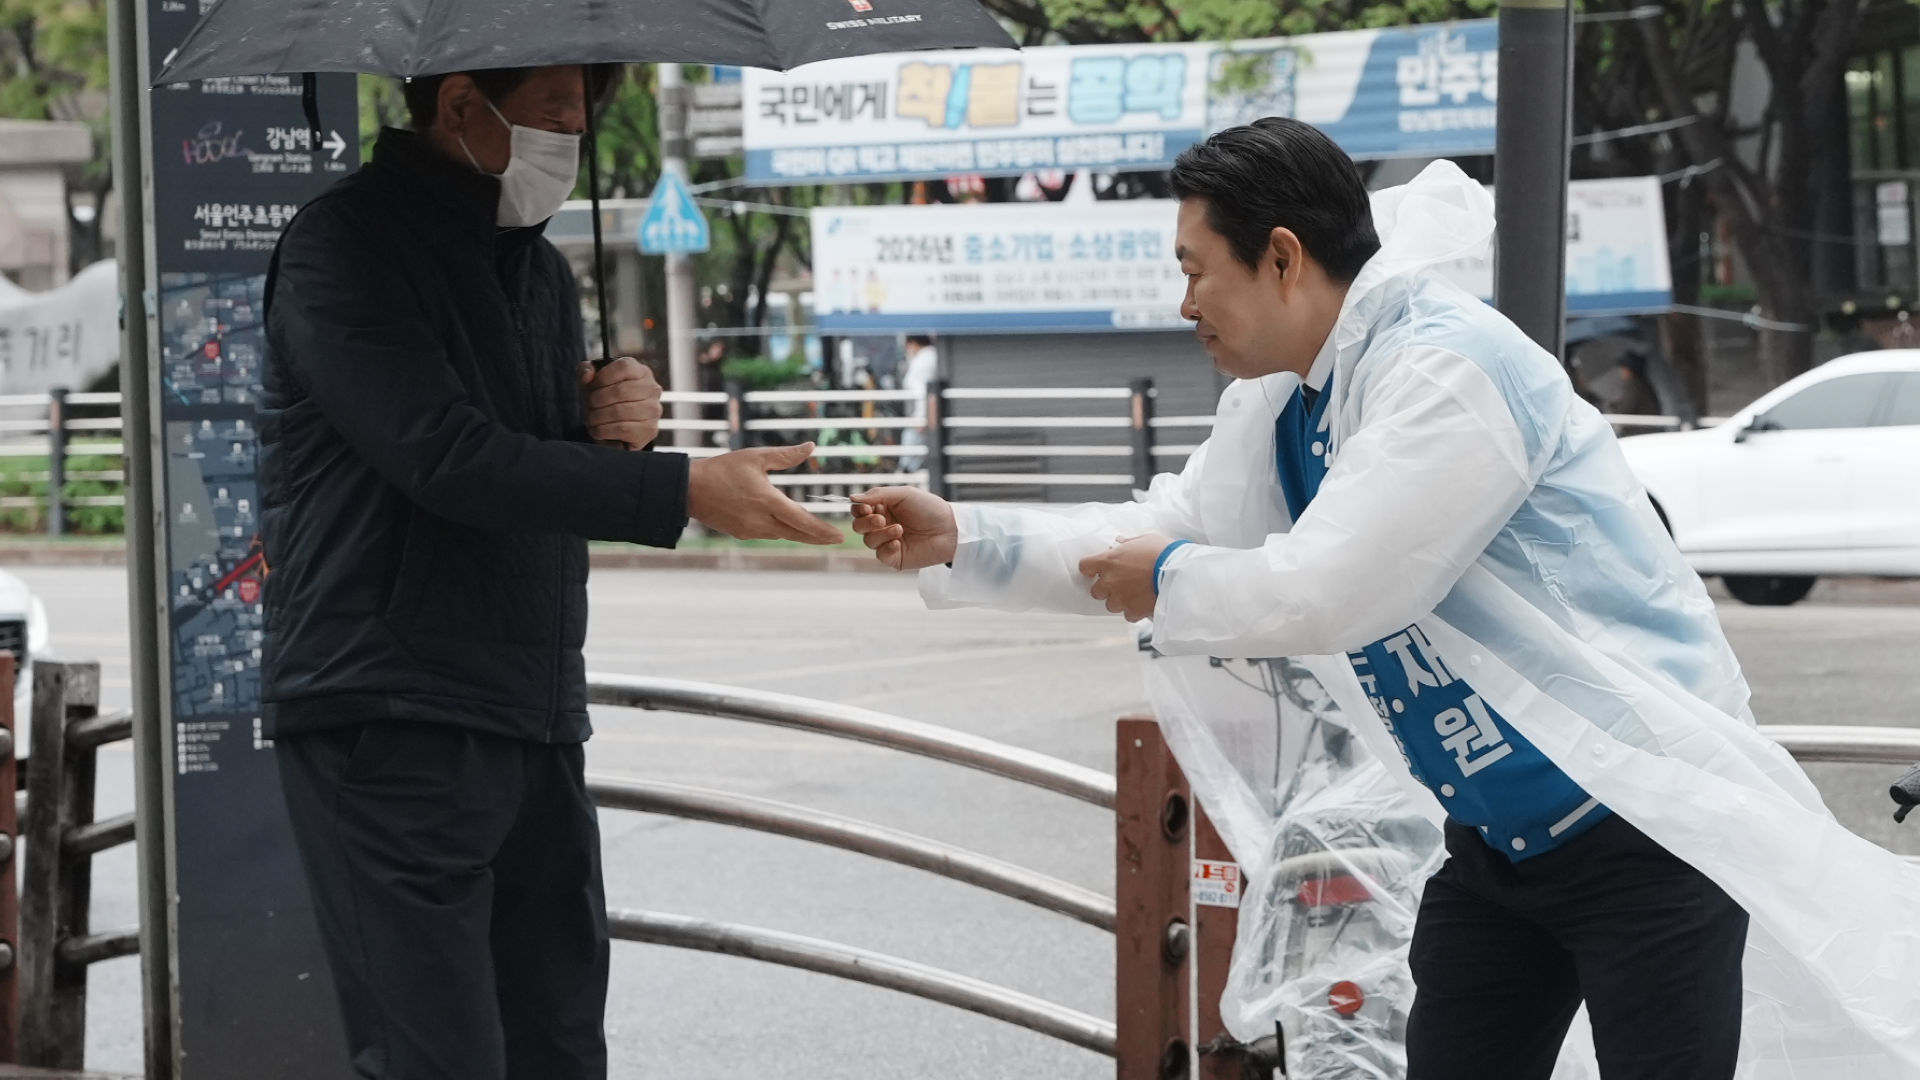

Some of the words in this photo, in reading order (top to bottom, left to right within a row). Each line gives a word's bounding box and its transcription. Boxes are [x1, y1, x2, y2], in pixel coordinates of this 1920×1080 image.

[826, 19, 867, 30] SWISS
[866, 14, 922, 25] MILITARY
[761, 82, 888, 125] 국민에게
[1067, 53, 1187, 125] 공약
[266, 127, 310, 150] 강남역
[876, 235, 956, 265] 2026년
